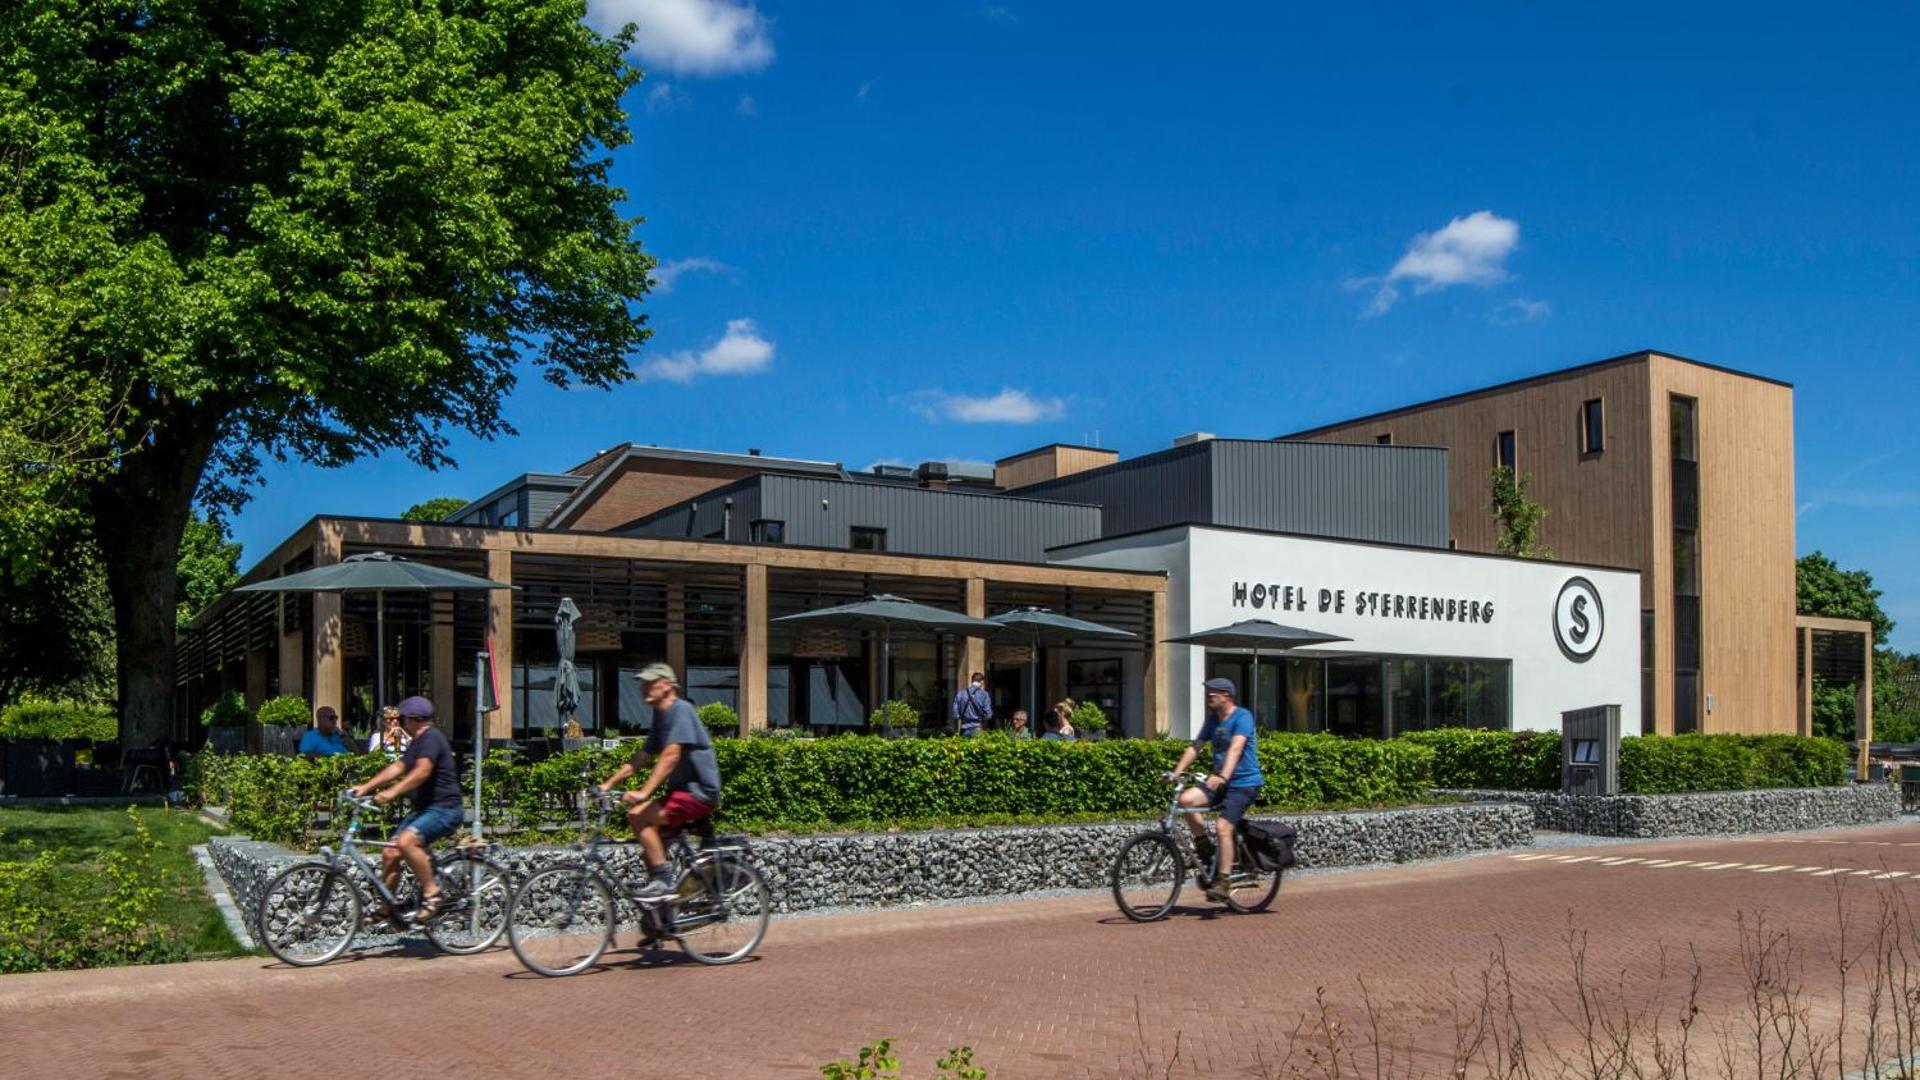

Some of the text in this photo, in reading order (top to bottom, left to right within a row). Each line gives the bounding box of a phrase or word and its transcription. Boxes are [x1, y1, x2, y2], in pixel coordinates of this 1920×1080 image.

[1233, 582, 1495, 624] HOTEL DE STERRENBERG
[1569, 594, 1590, 644] S
